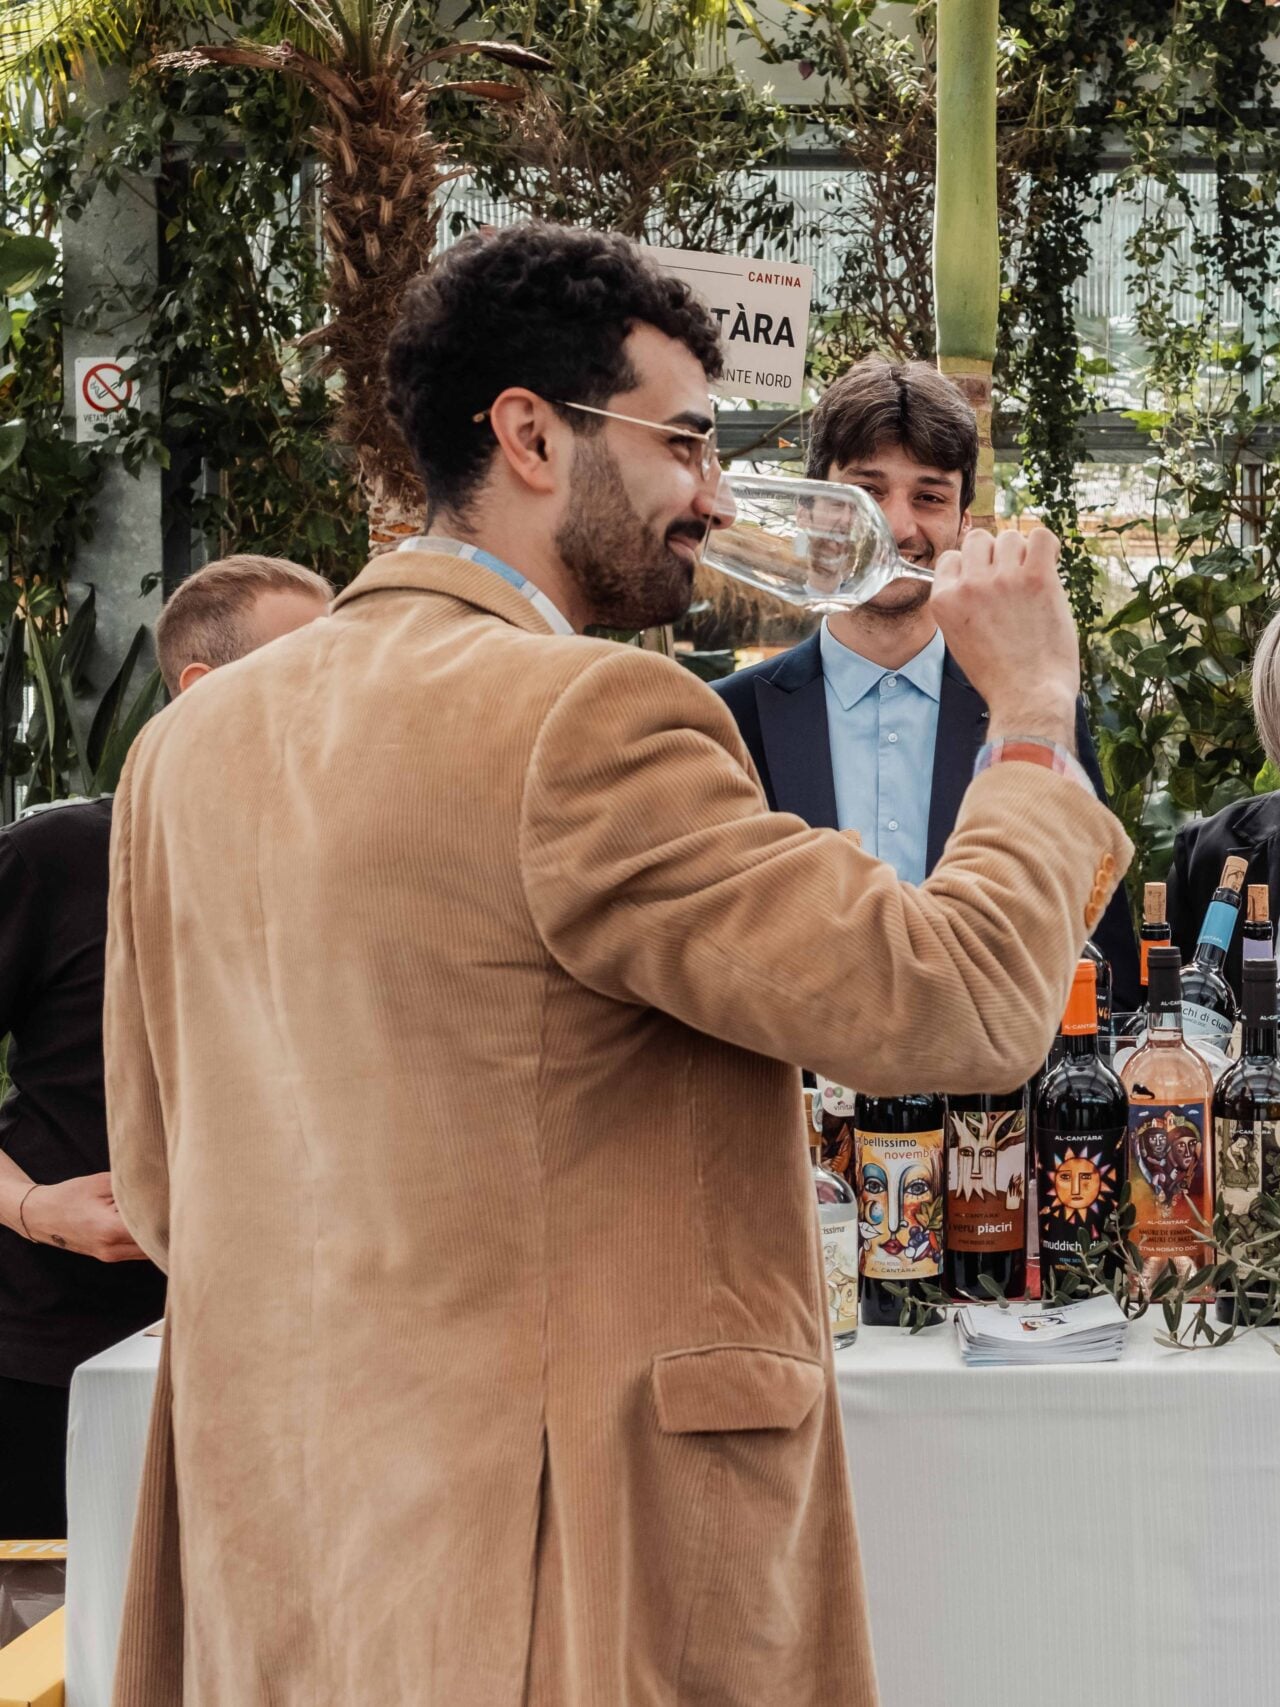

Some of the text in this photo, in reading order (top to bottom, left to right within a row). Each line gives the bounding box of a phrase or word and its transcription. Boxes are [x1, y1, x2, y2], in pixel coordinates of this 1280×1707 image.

[748, 271, 801, 288] CANTINA
[755, 372, 792, 389] NORD
[863, 1136, 917, 1148] bellissimo
[977, 1221, 1012, 1236] piaciri
